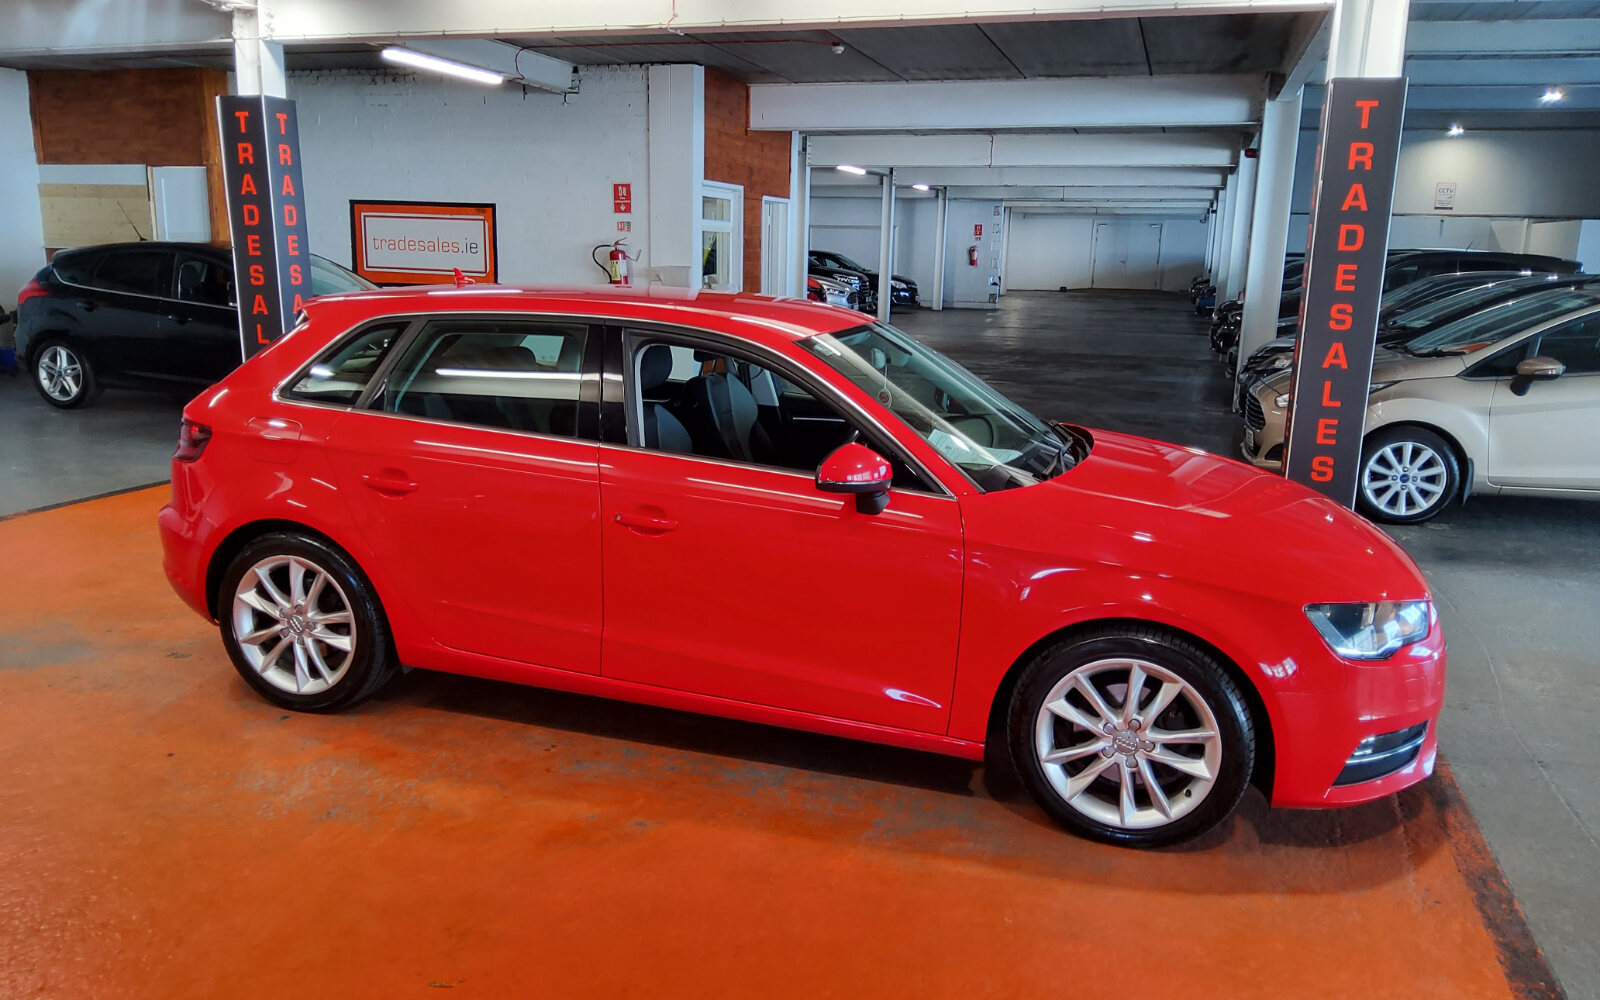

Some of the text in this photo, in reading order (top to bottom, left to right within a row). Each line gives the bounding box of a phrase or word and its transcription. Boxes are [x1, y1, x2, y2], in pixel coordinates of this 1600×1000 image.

[235, 111, 270, 344] TRADESAL
[372, 235, 478, 254] tradesales.ie
[1310, 100, 1380, 482] TRADESALES
